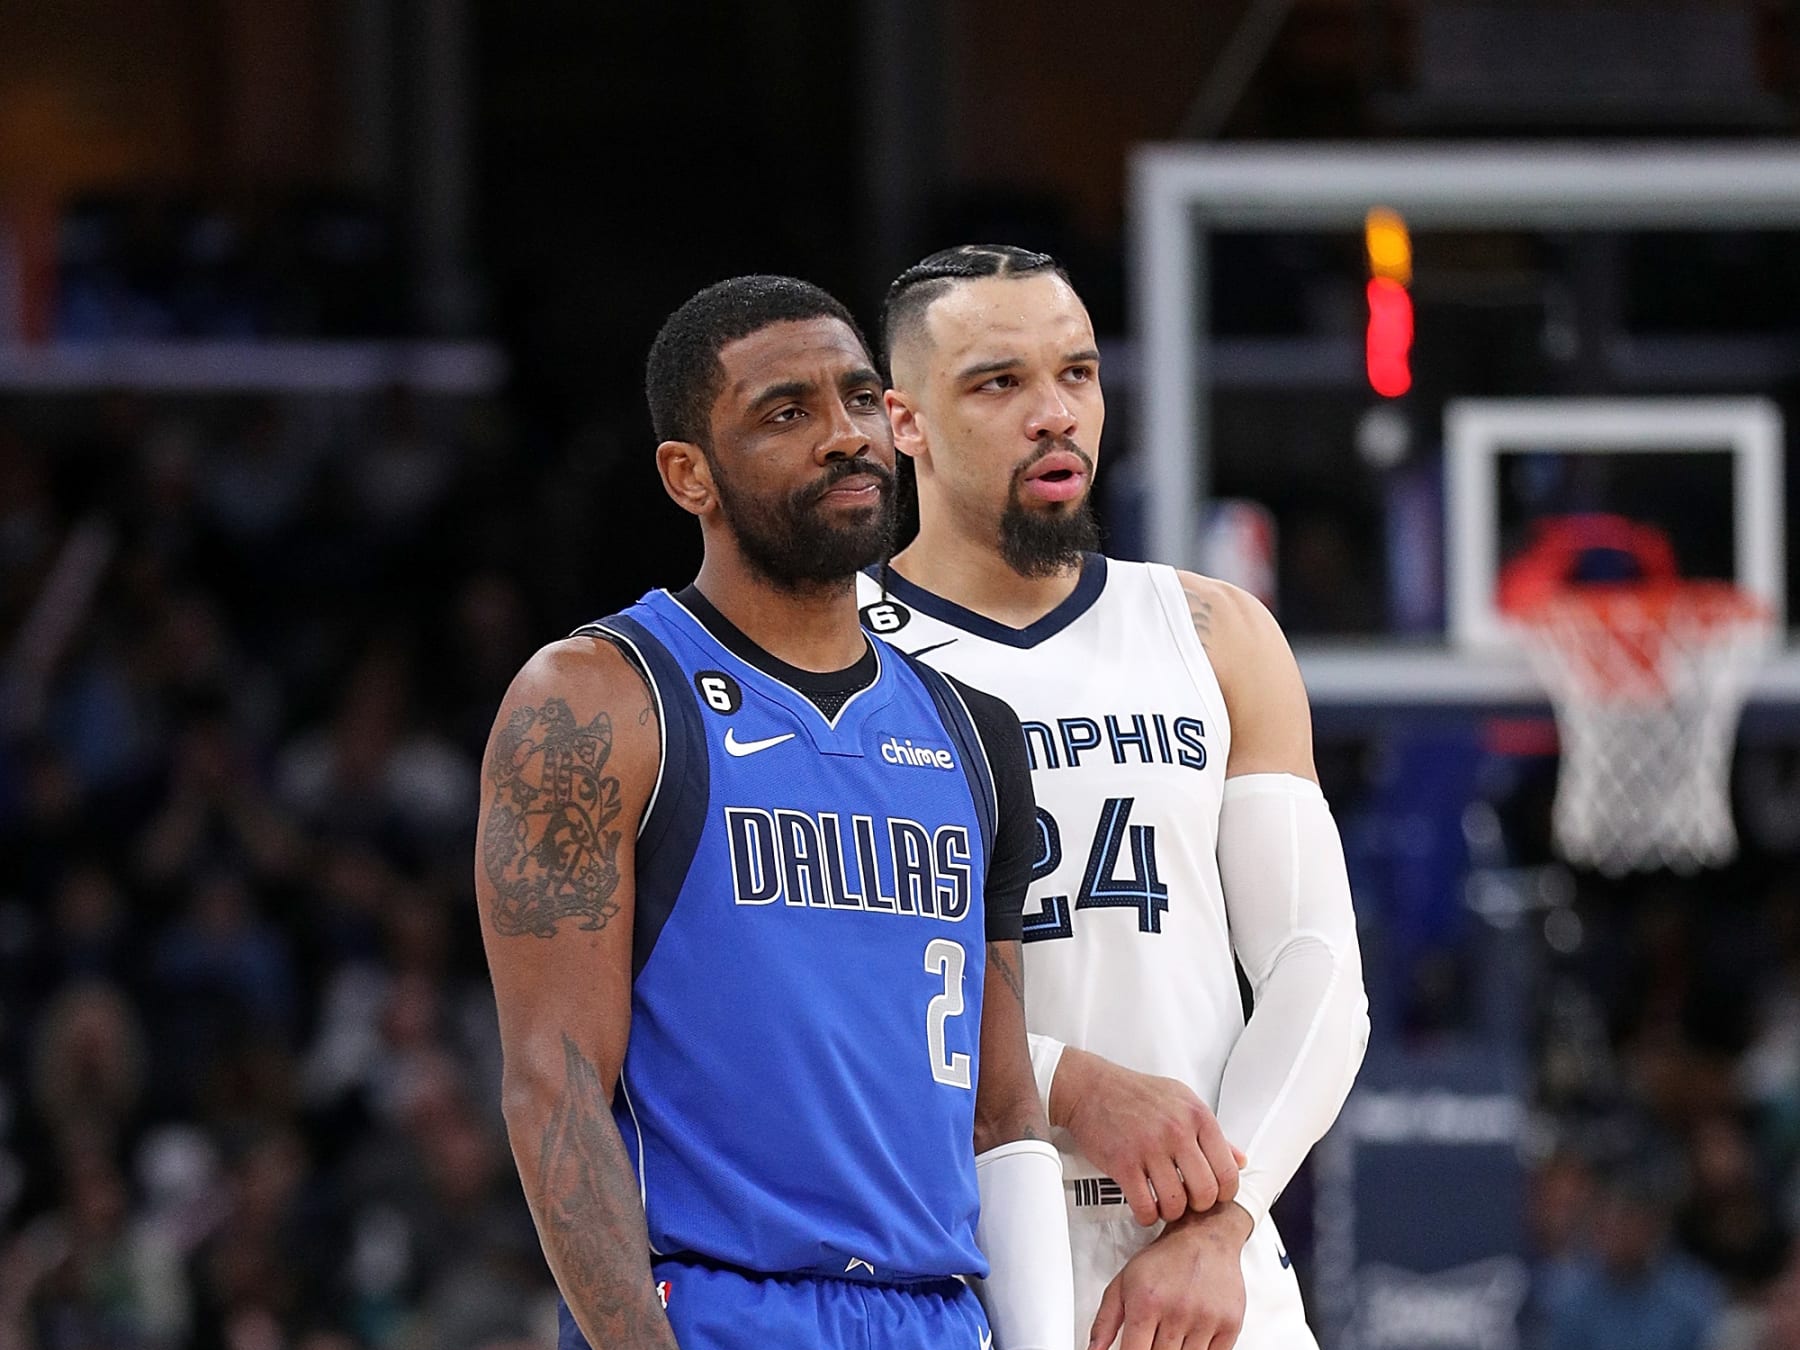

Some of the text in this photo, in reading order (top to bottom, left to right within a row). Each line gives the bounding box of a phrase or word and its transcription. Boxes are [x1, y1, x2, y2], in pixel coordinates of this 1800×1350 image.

[867, 604, 901, 631] 6
[701, 677, 732, 711] 6
[881, 737, 955, 769] chime
[1020, 714, 1207, 771] MPHIS
[724, 807, 971, 922] DALLAS
[1022, 797, 1168, 944] 24
[924, 939, 972, 1090] 2
